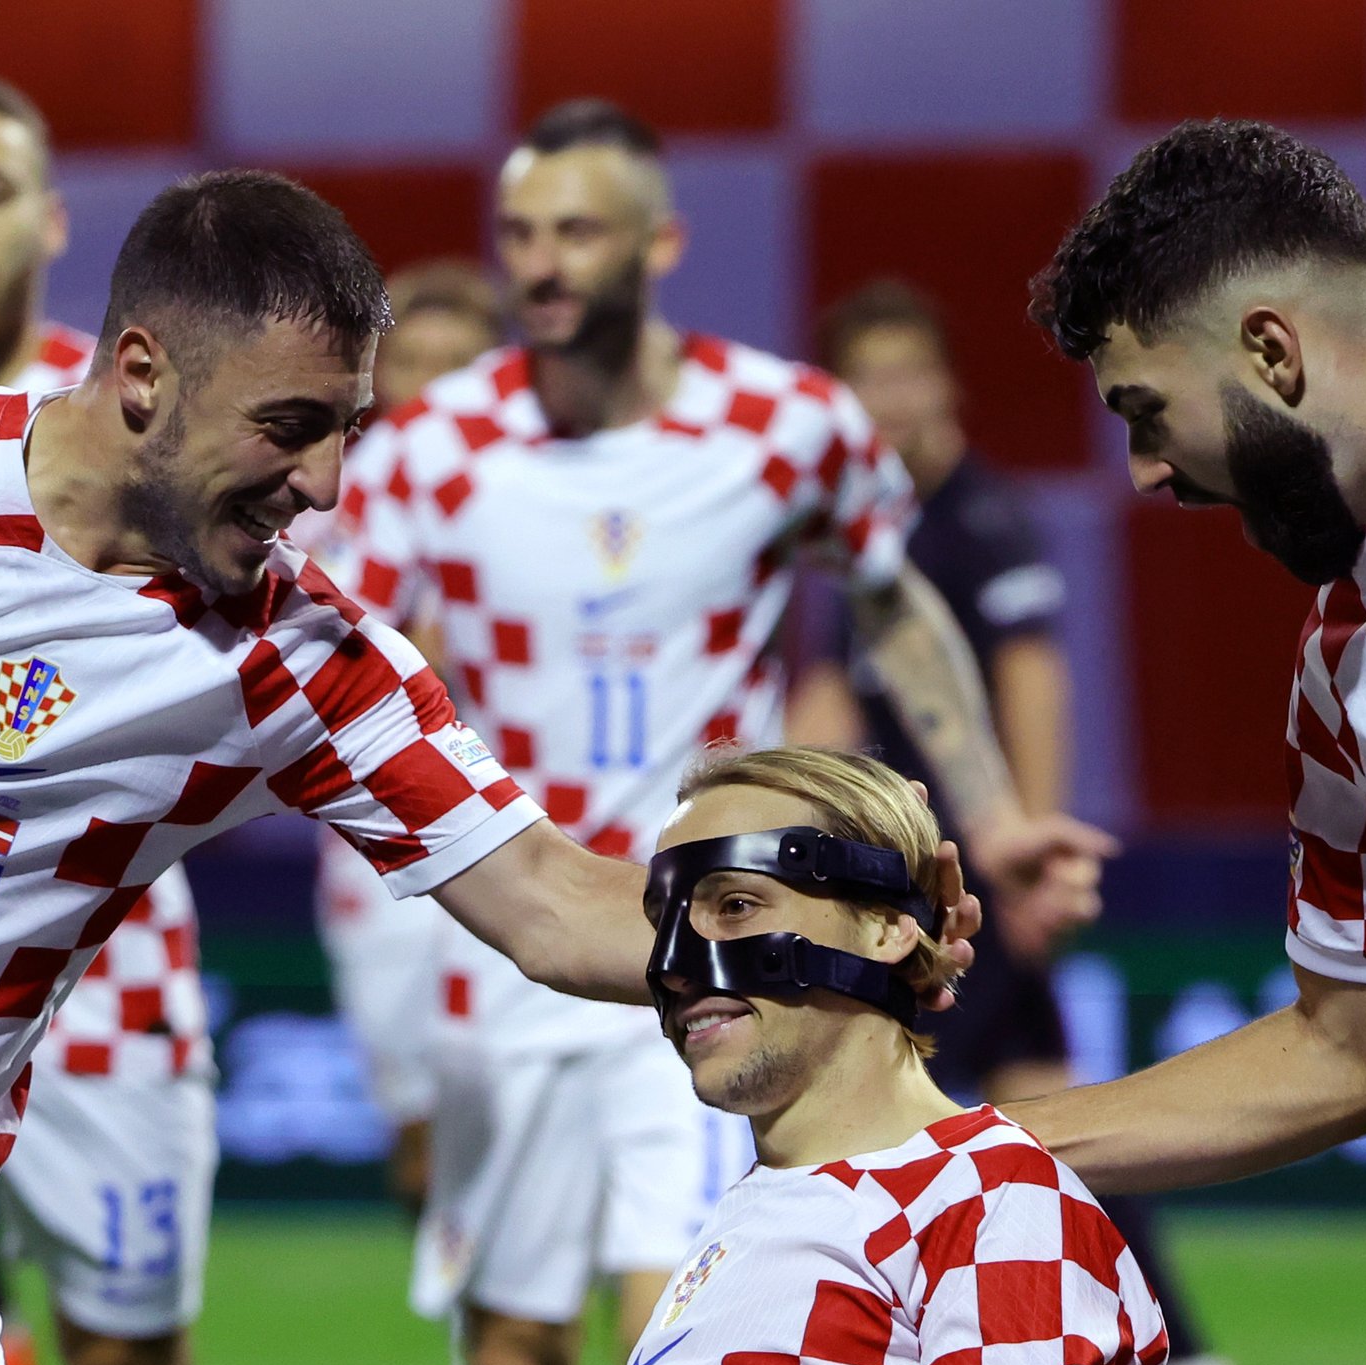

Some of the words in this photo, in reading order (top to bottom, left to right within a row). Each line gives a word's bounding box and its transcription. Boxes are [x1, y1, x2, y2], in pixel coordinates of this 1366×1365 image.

[16, 667, 48, 721] HNS
[590, 671, 647, 769] 11
[99, 1178, 179, 1275] 13
